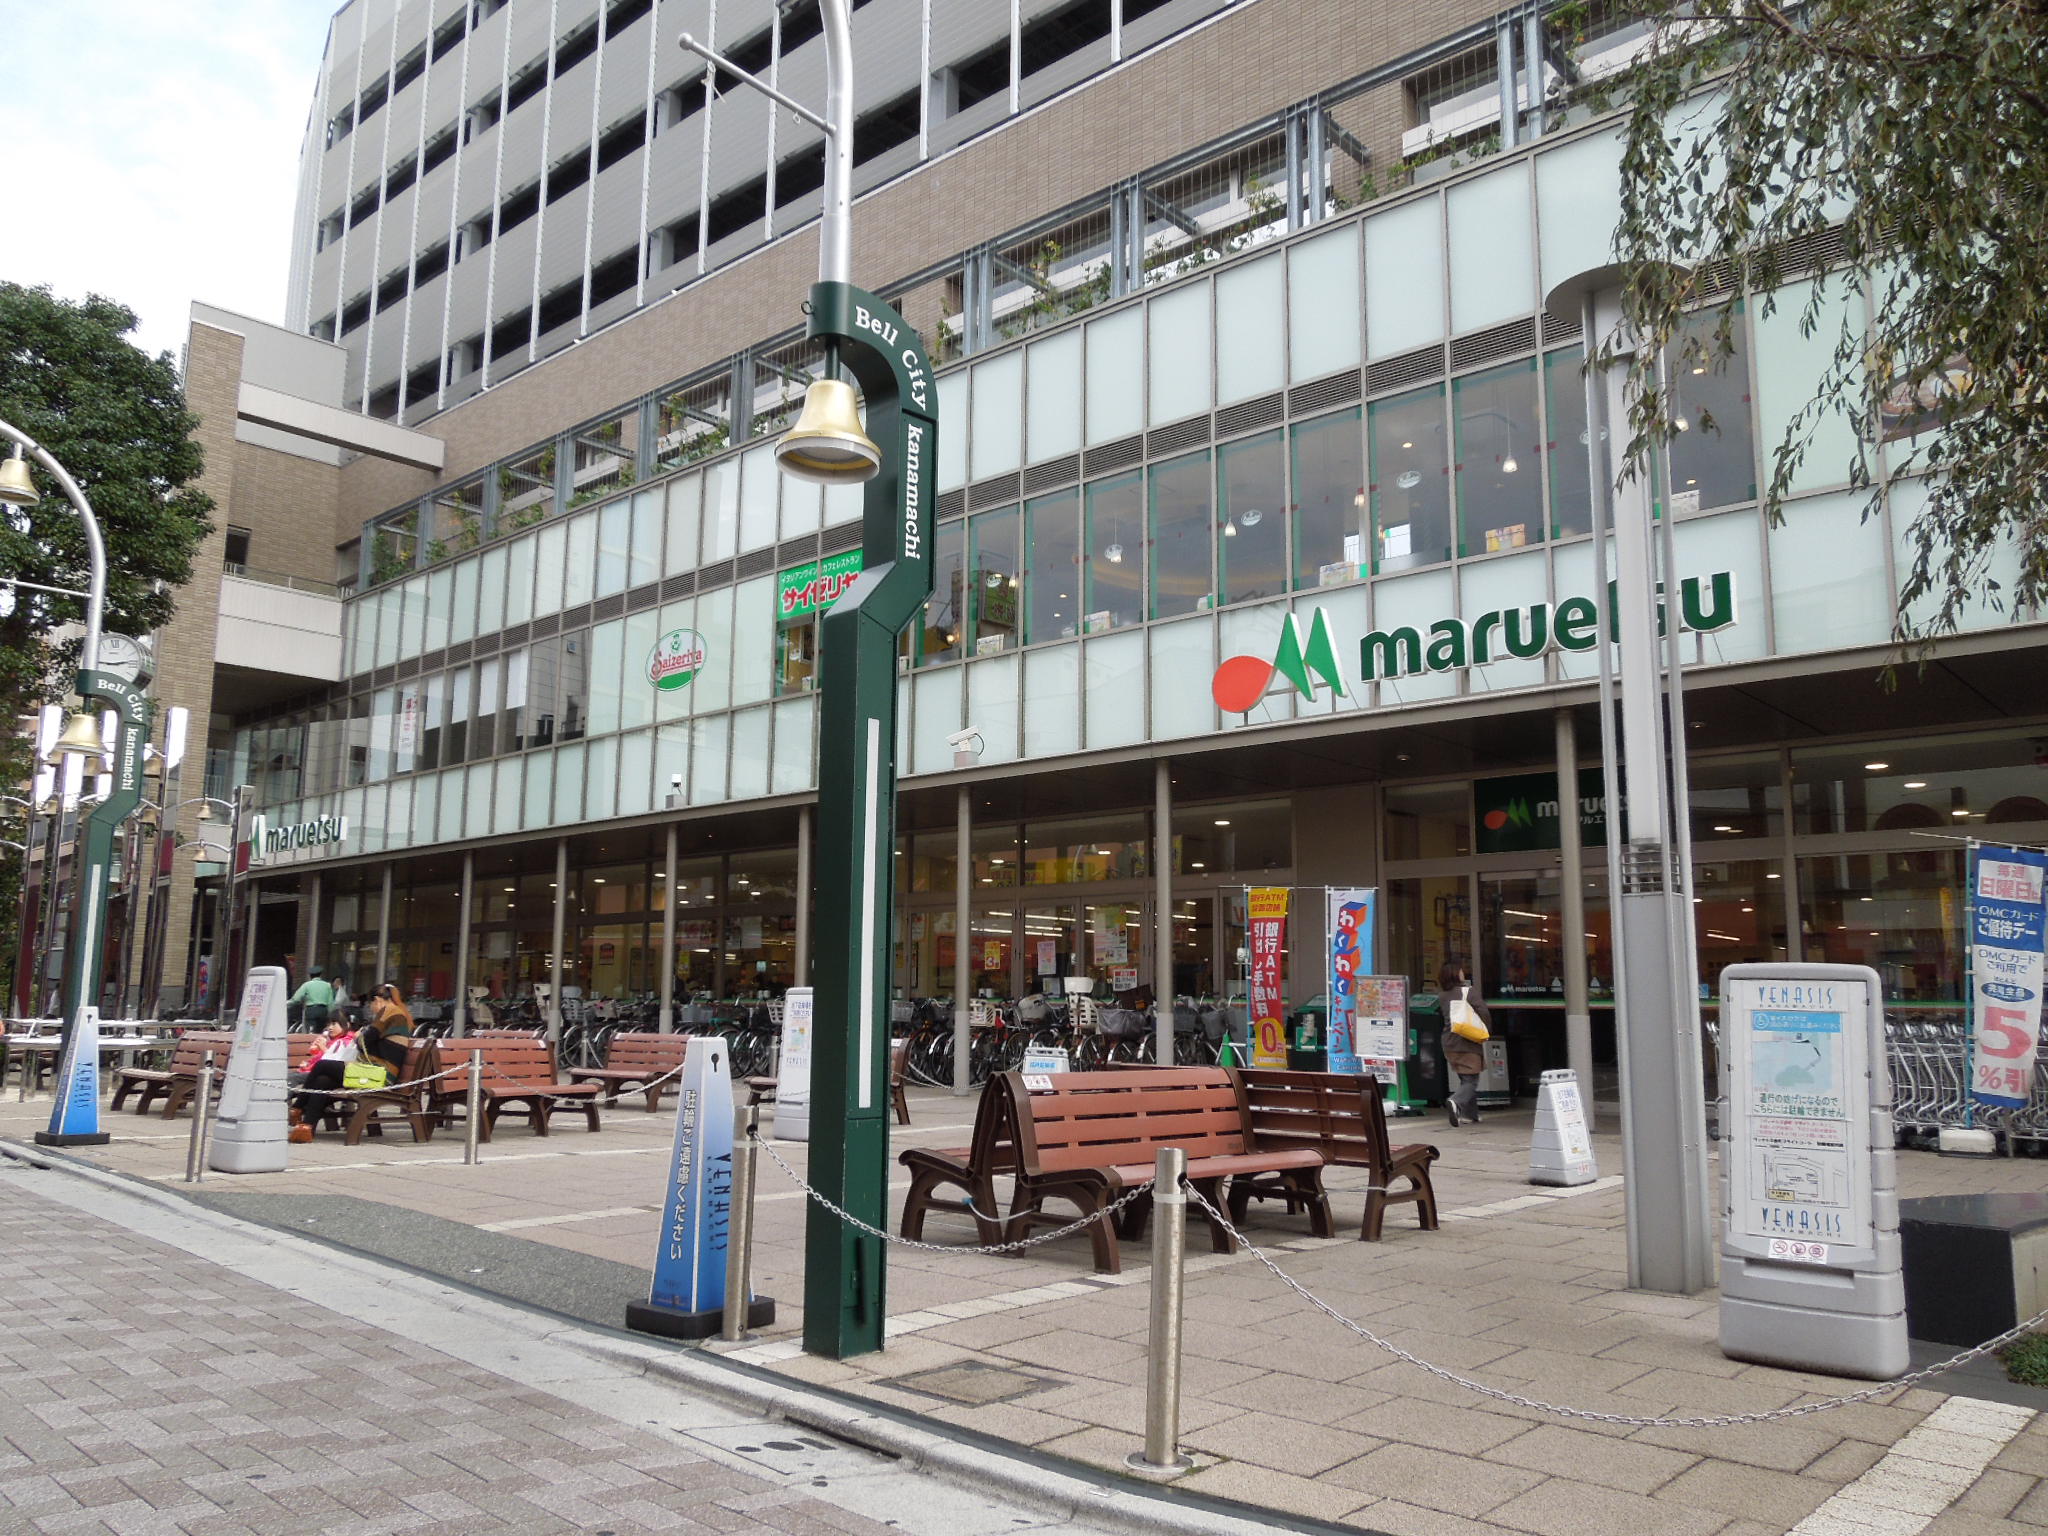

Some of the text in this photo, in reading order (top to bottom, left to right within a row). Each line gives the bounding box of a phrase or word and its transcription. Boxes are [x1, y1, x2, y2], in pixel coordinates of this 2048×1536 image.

[855, 305, 927, 411] Bell City
[904, 423, 923, 560] kanamachi
[782, 555, 860, 582] イタリアンワインカフェレストラン
[1359, 571, 1737, 684] marueu
[97, 679, 144, 722] Bell City
[121, 727, 138, 791] kanamachi
[265, 815, 345, 852] maruetsu
[1998, 864, 2026, 878] 毎週
[1978, 918, 2038, 939] ご優待デー
[1979, 905, 2040, 921] OMCカード
[1265, 922, 1279, 1001] 銀行ATM
[1336, 910, 1355, 993] わくわく
[1979, 949, 2037, 964] OMCカード
[1987, 960, 2028, 975] ご利用で
[1759, 986, 1833, 1005] VENASIS
[1980, 1006, 2032, 1059] 5
[1761, 1207, 1841, 1233] VENASIS
